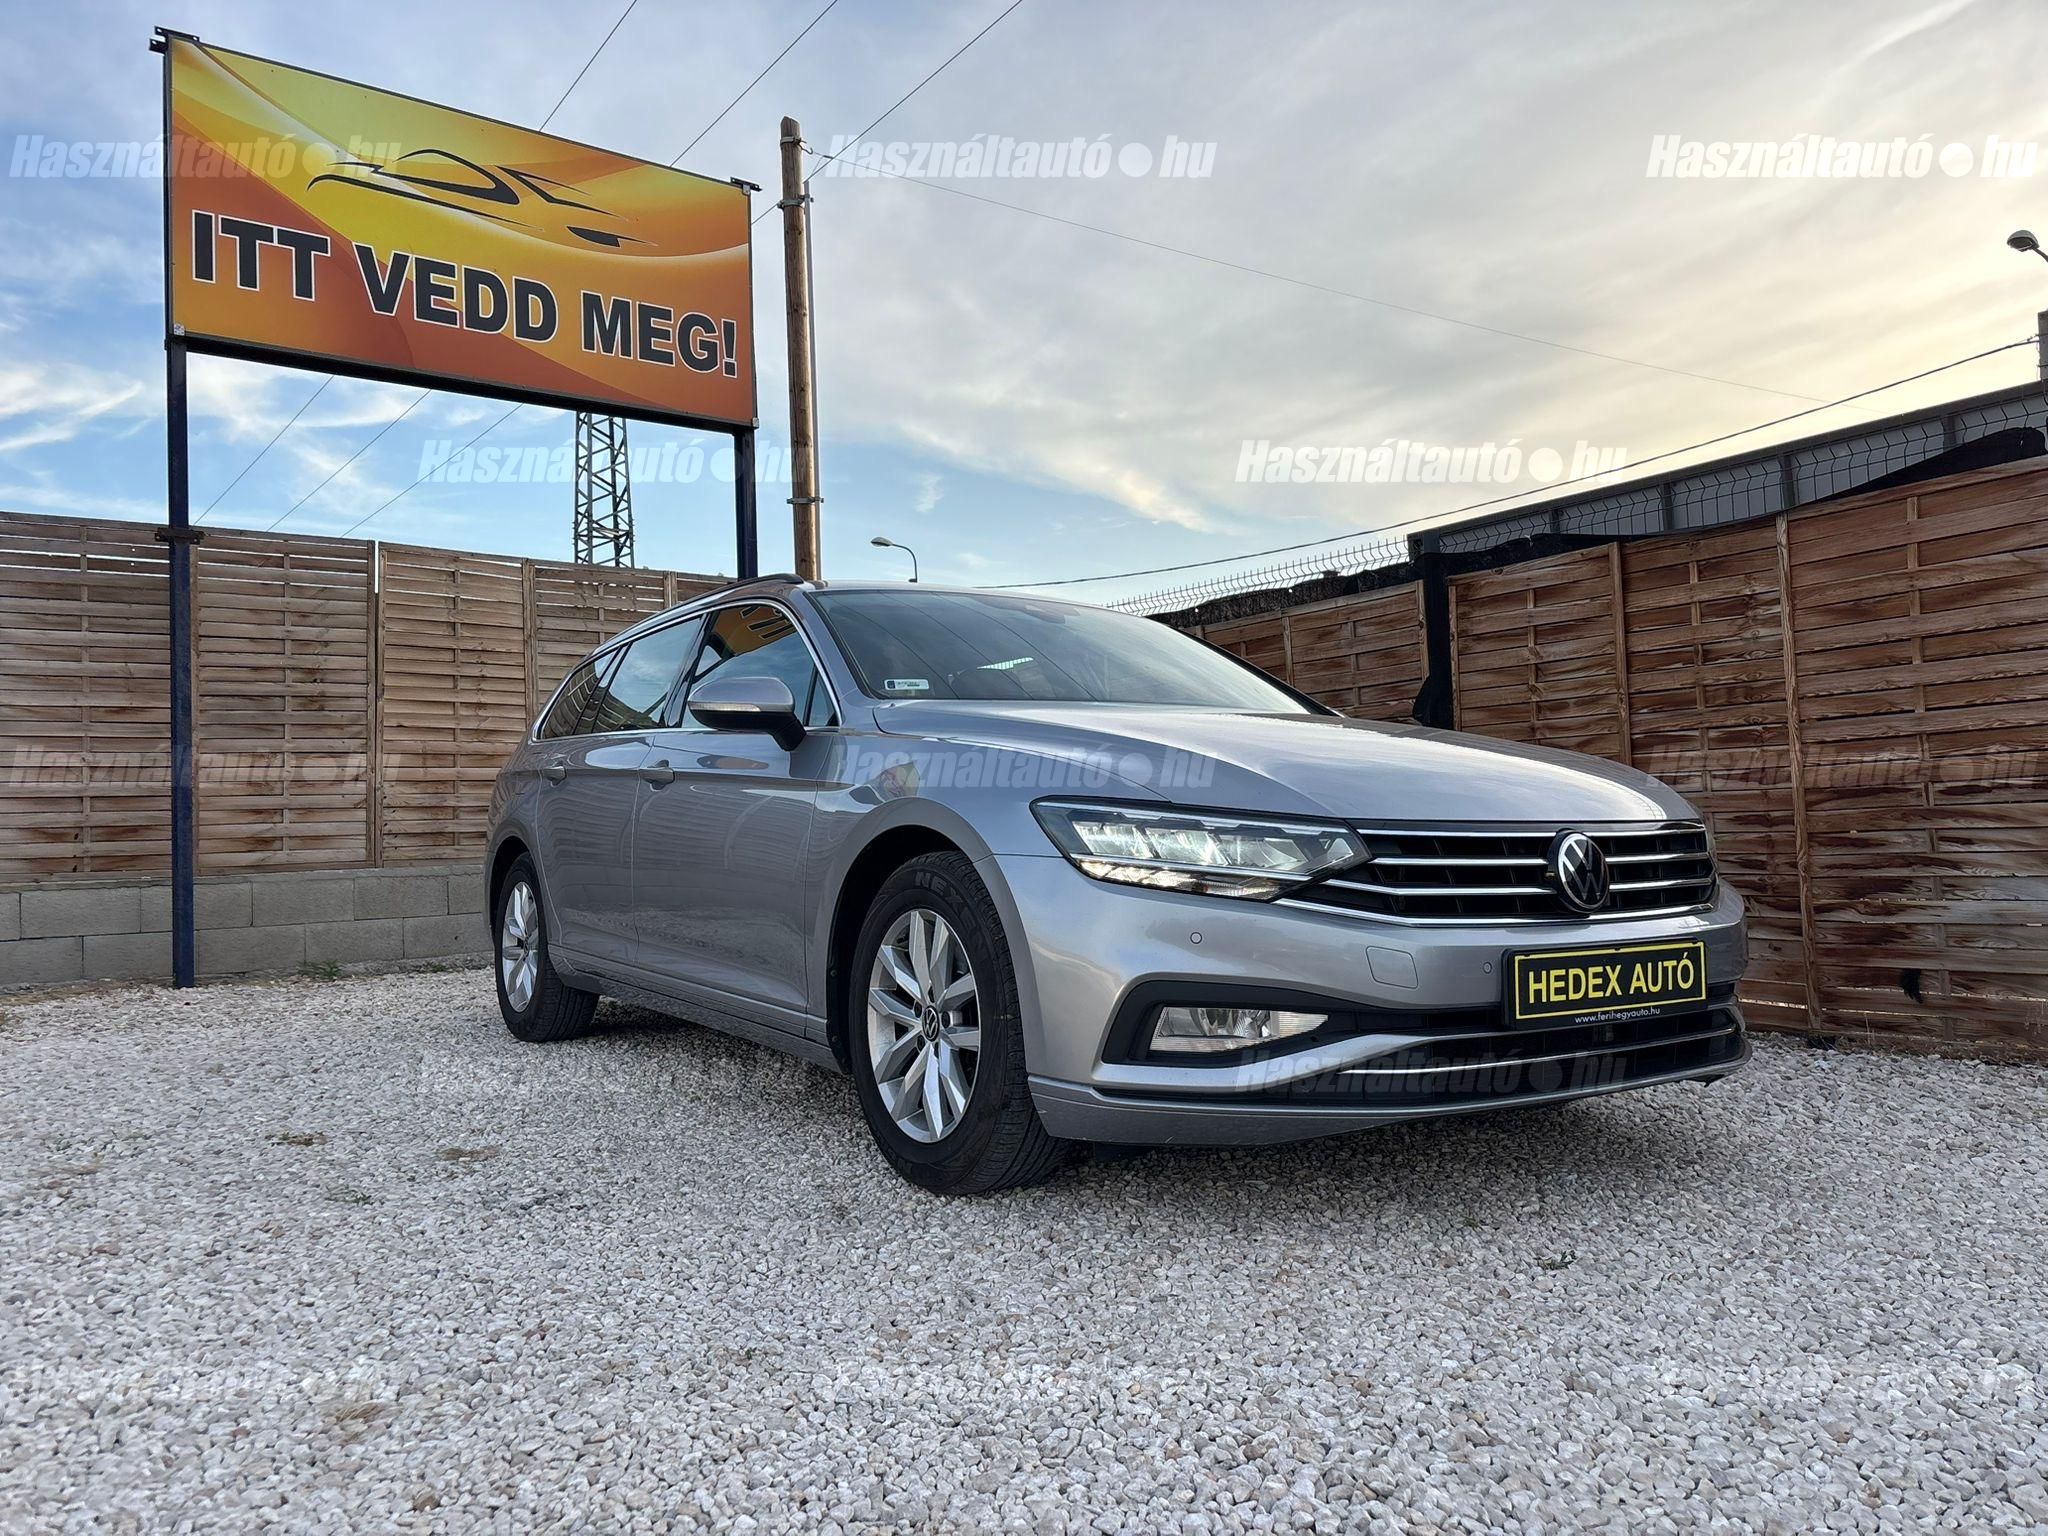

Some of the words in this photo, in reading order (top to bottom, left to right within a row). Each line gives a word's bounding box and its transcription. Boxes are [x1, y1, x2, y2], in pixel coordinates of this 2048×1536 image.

[192, 209, 331, 301] ITT
[352, 240, 559, 343] VEDD
[580, 289, 737, 378] MEG!
[1528, 964, 1623, 1004] HEDEX
[1629, 951, 1695, 995] AUTÓ
[1574, 1006, 1662, 1024] www.ferihegyauto.hu
